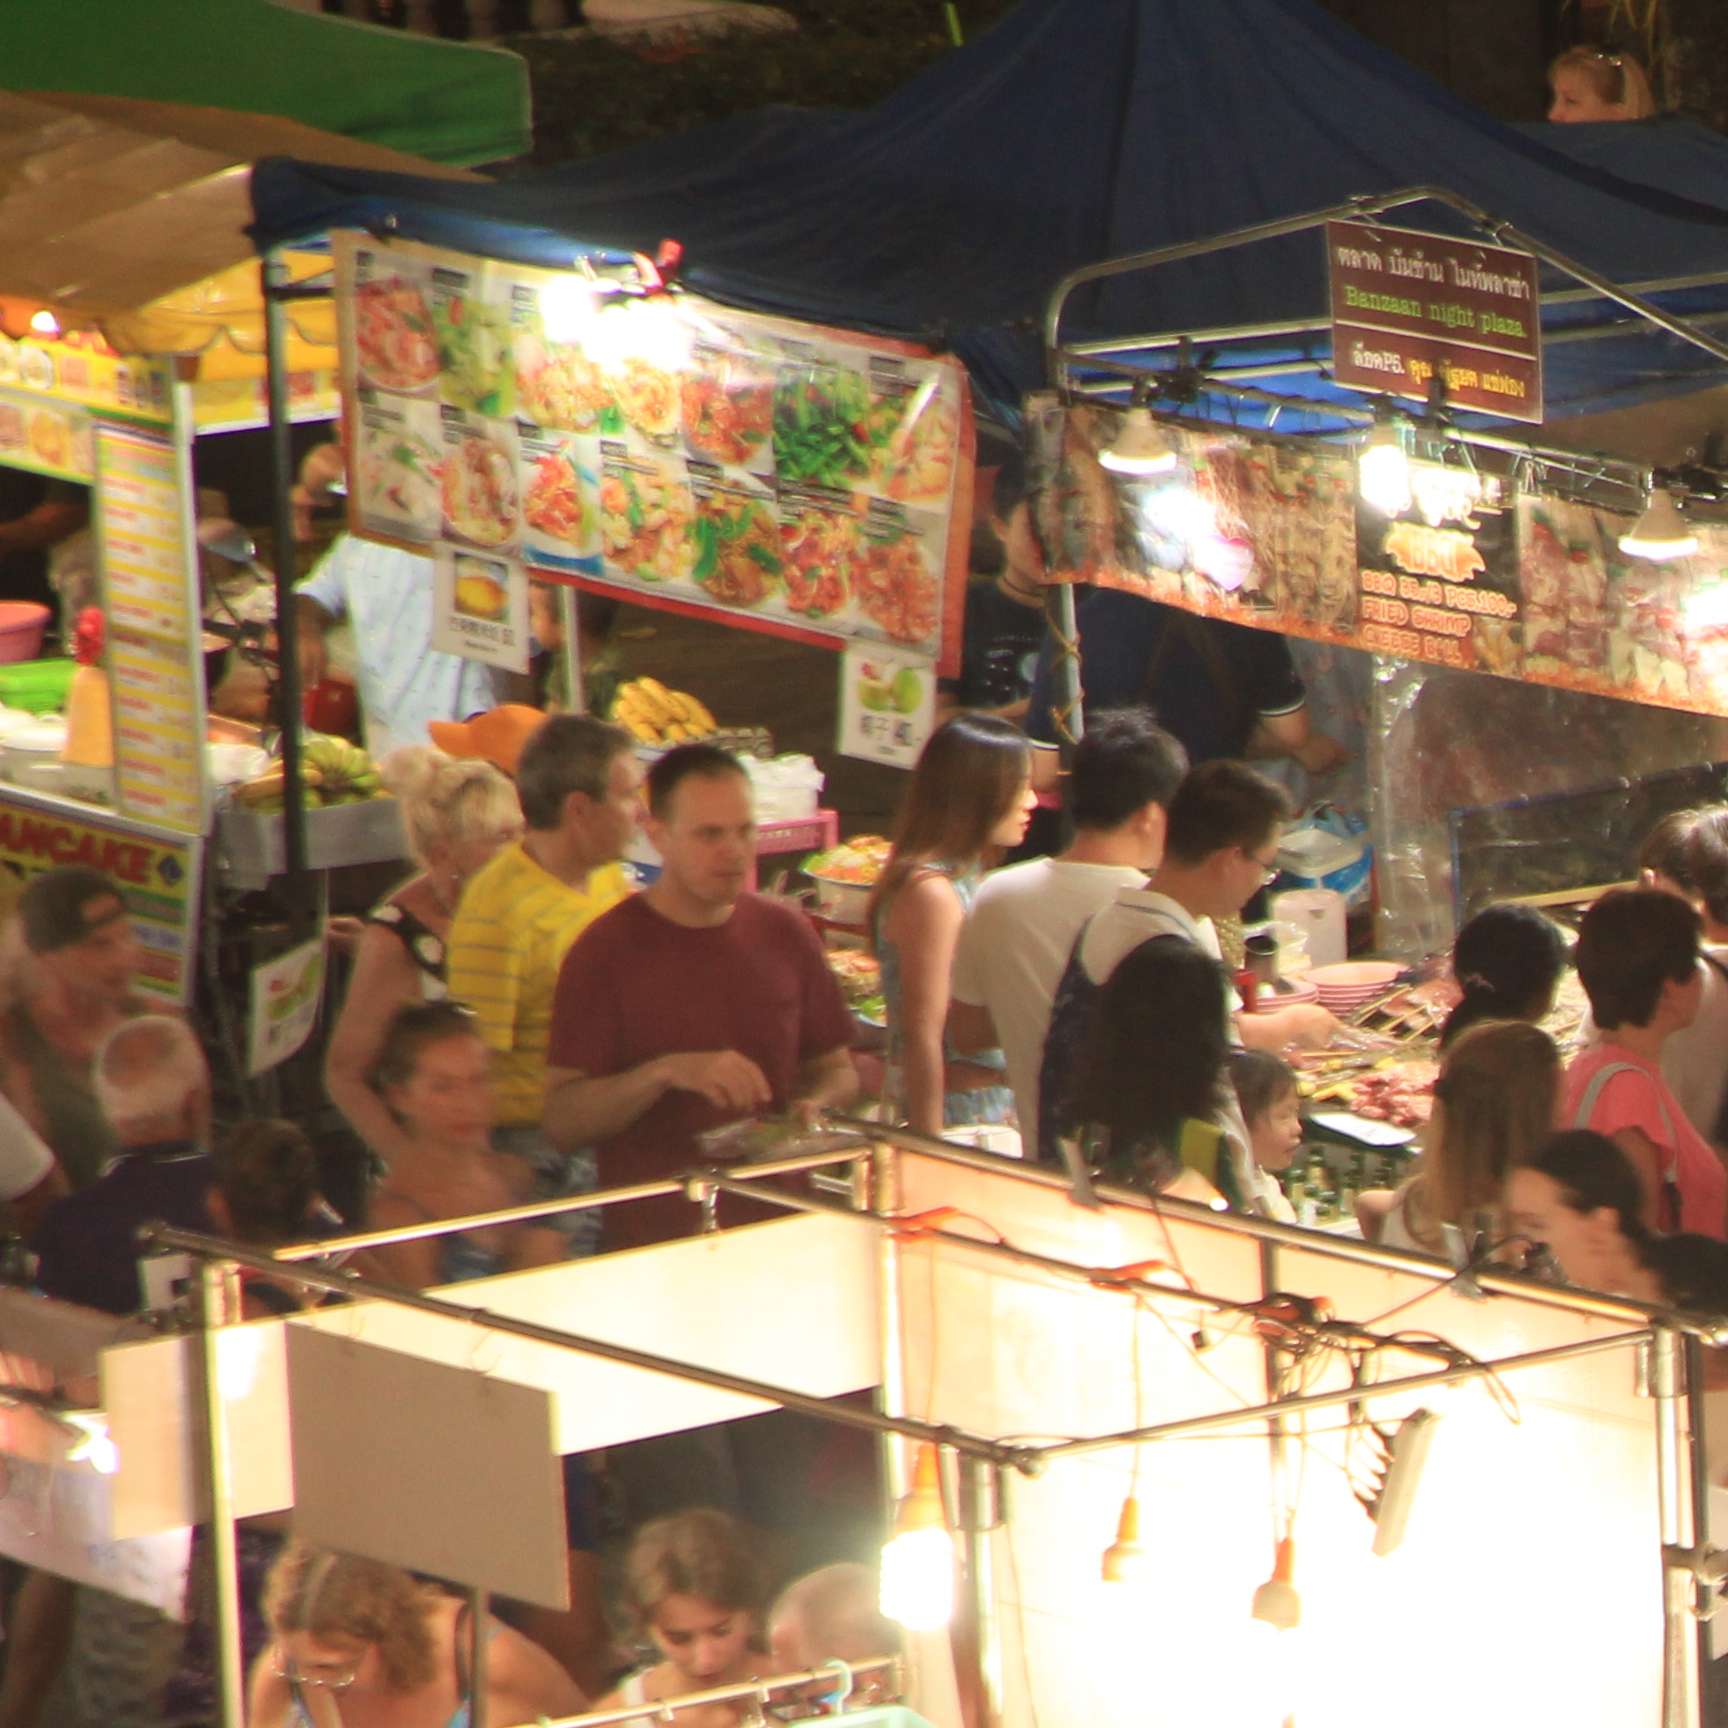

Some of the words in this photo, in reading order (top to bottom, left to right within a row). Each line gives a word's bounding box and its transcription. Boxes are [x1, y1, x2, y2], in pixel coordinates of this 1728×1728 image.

[1344, 285, 1423, 318] Banzaan
[1427, 301, 1476, 328] night
[1478, 311, 1528, 338] plaza
